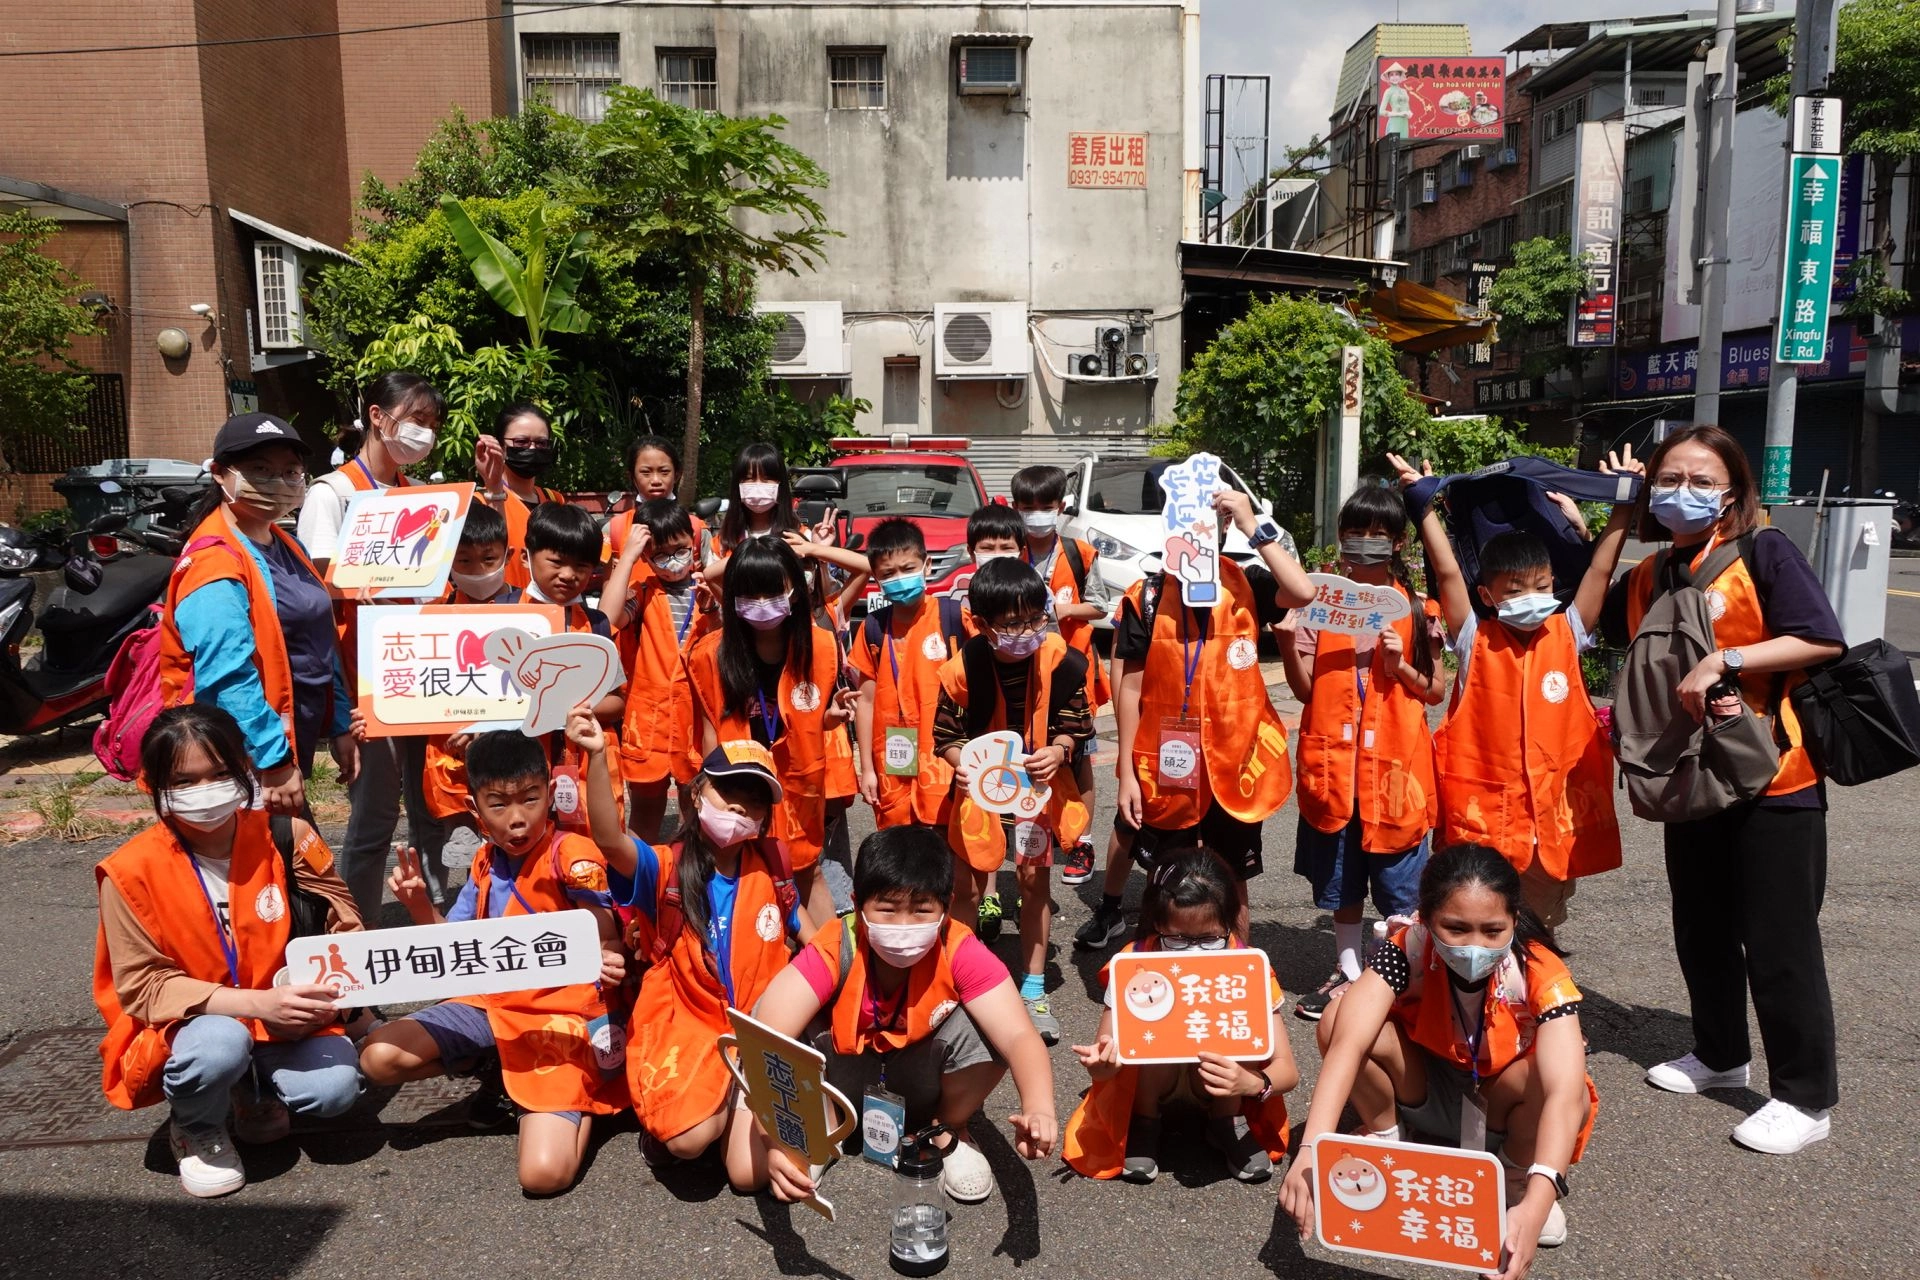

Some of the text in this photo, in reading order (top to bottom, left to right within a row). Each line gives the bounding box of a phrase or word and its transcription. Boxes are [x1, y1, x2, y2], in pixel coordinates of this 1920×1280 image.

[1811, 99, 1824, 149] 新莊區
[1071, 135, 1144, 167] 套房出租
[1793, 180, 1825, 324] 幸福東路
[1783, 346, 1816, 357] E. Rd.
[1785, 328, 1821, 342] Xingfu
[352, 511, 395, 536] 志工
[341, 540, 405, 567] 愛很大
[1309, 607, 1384, 630] 陪你到老
[382, 631, 451, 662] 志工
[382, 666, 488, 699] 愛很大
[364, 930, 569, 986] 伊甸基金會
[1179, 973, 1248, 1006] 我超
[1183, 1009, 1252, 1042] 幸福
[1391, 1168, 1475, 1208] 我超
[1398, 1207, 1479, 1250] 幸福
